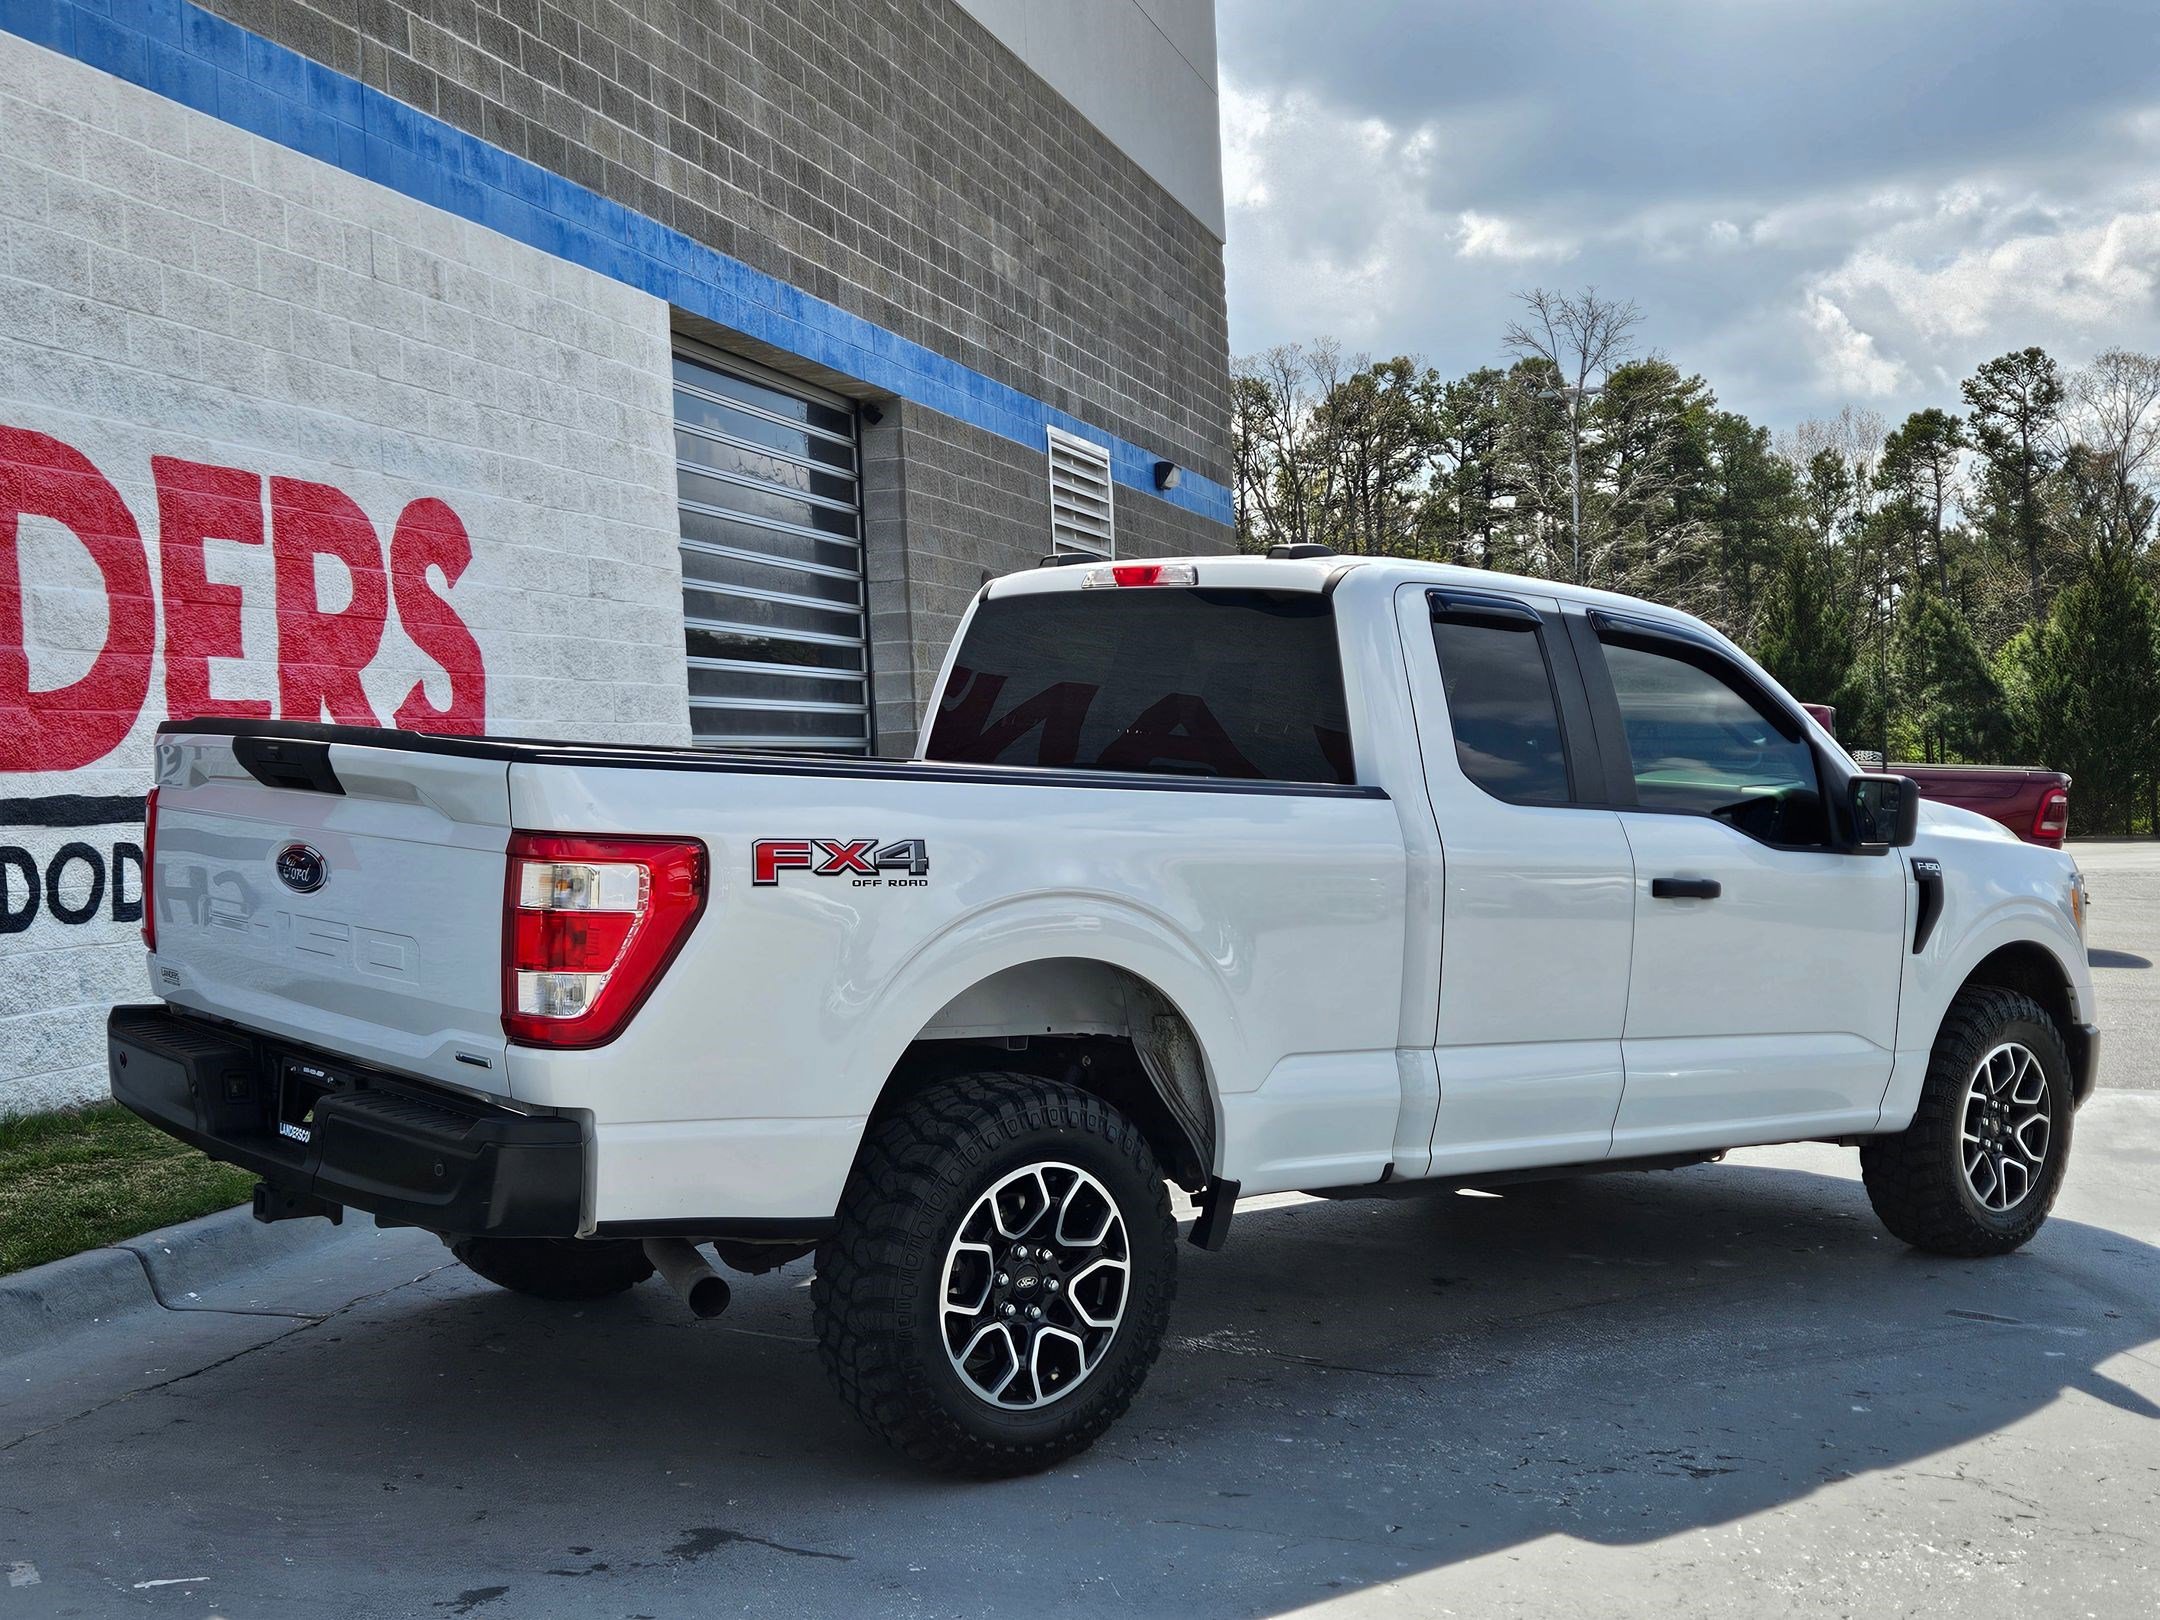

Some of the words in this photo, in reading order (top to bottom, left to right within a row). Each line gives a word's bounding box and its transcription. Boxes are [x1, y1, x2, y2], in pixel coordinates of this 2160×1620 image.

[0, 425, 486, 772] DERS
[752, 838, 929, 887] FX4
[1917, 862, 1941, 871] F-150
[852, 879, 882, 887] OFF
[888, 879, 928, 887] ROAD
